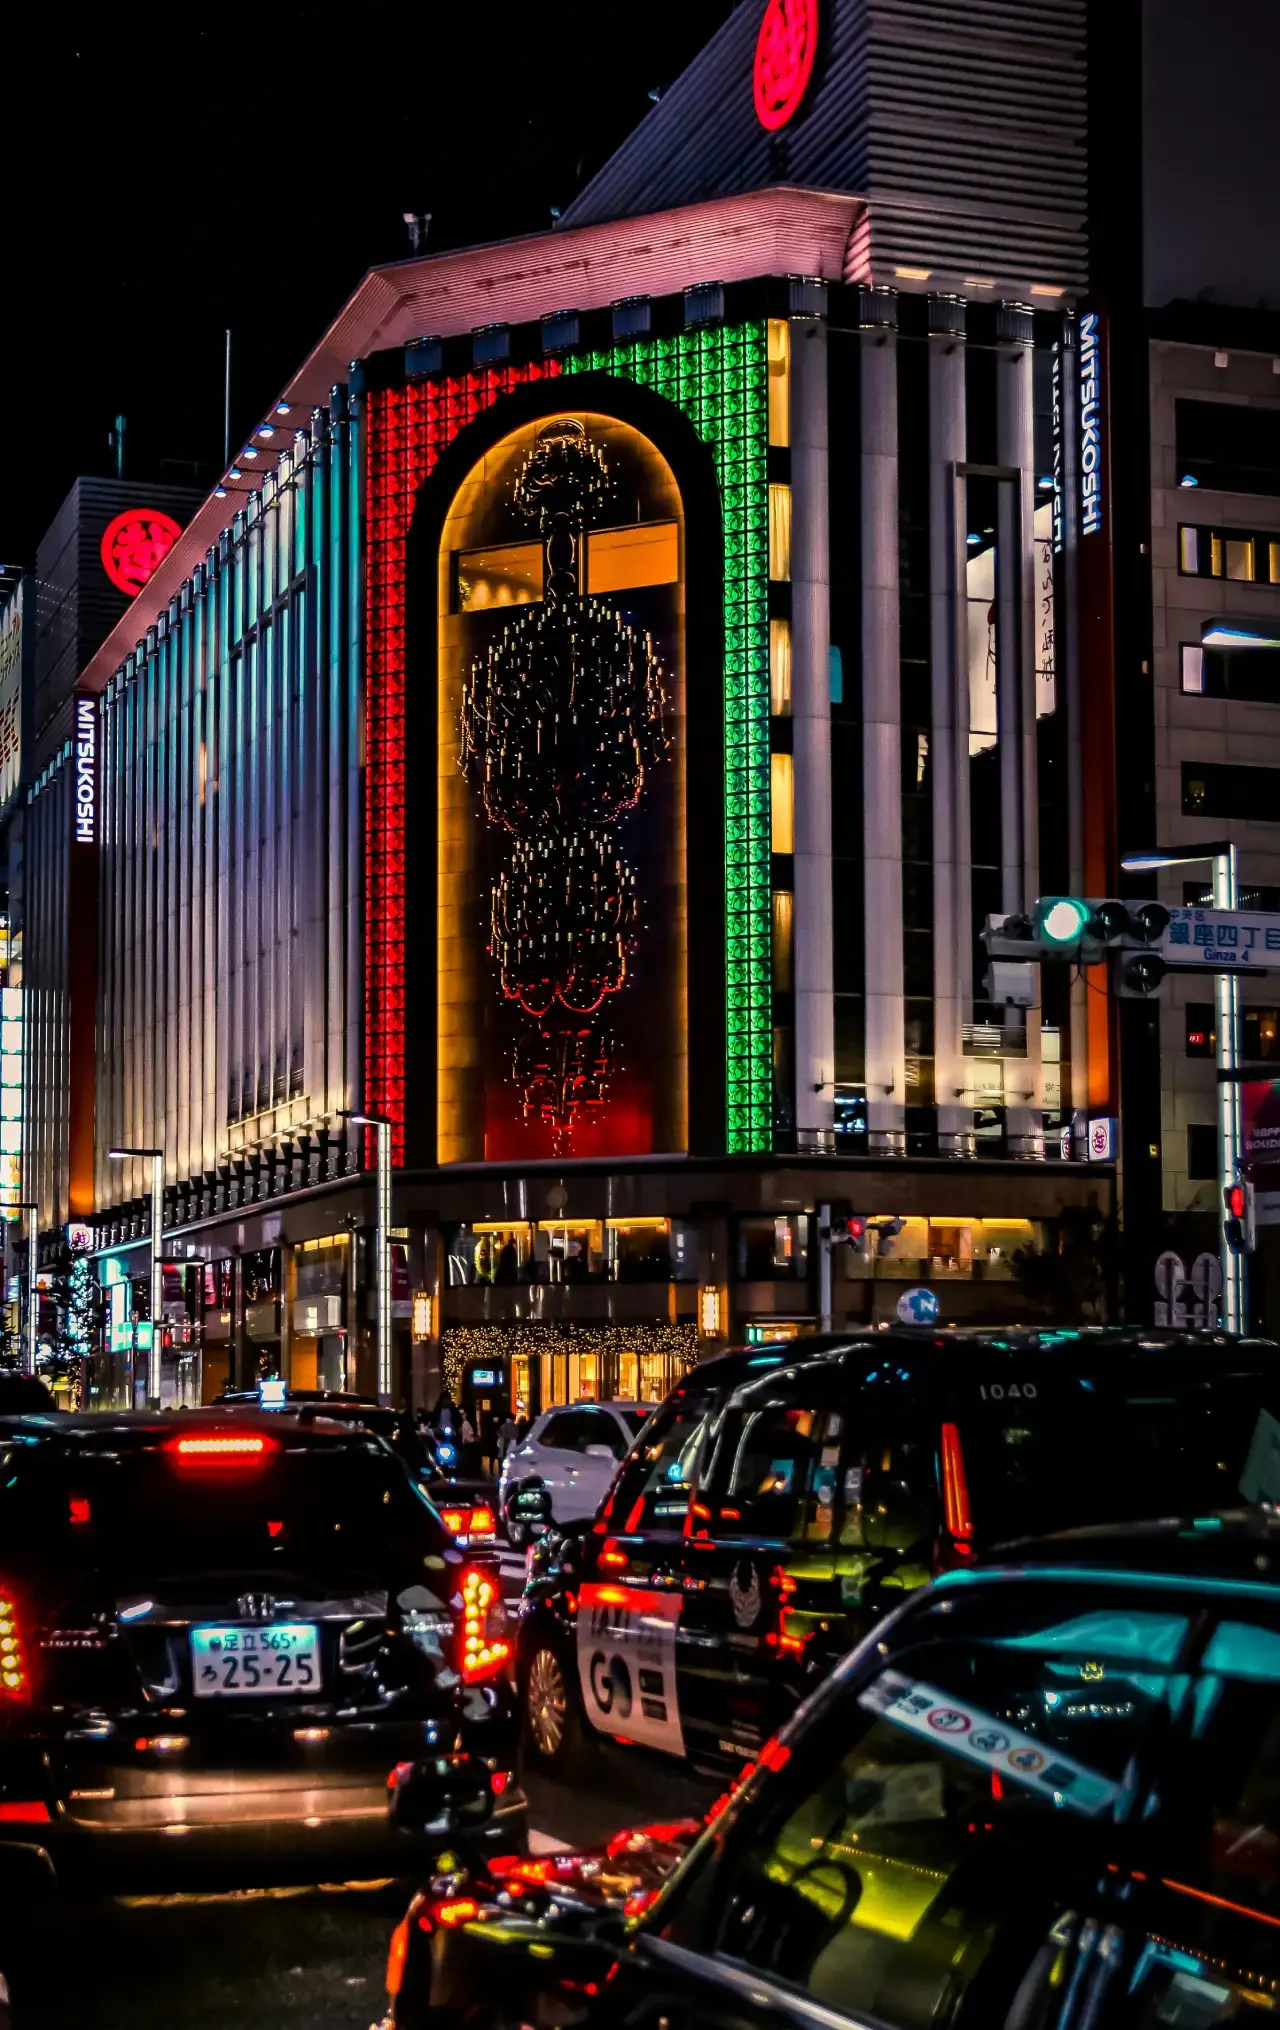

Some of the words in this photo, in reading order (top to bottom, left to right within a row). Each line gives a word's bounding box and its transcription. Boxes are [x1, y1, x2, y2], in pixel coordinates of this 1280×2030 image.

[1080, 312, 1098, 536] MITSUKOSHI
[76, 700, 95, 843] MITSUKOSHI
[1169, 909, 1205, 921] 中央区
[1169, 922, 1280, 949] 銀座四丁目
[1204, 947, 1237, 961] Ginza
[1240, 950, 1249, 962] 4
[980, 1383, 1036, 1400] 1040
[260, 1632, 291, 1650] 565
[222, 1653, 313, 1688] 25-25
[590, 1650, 633, 1719] GO
